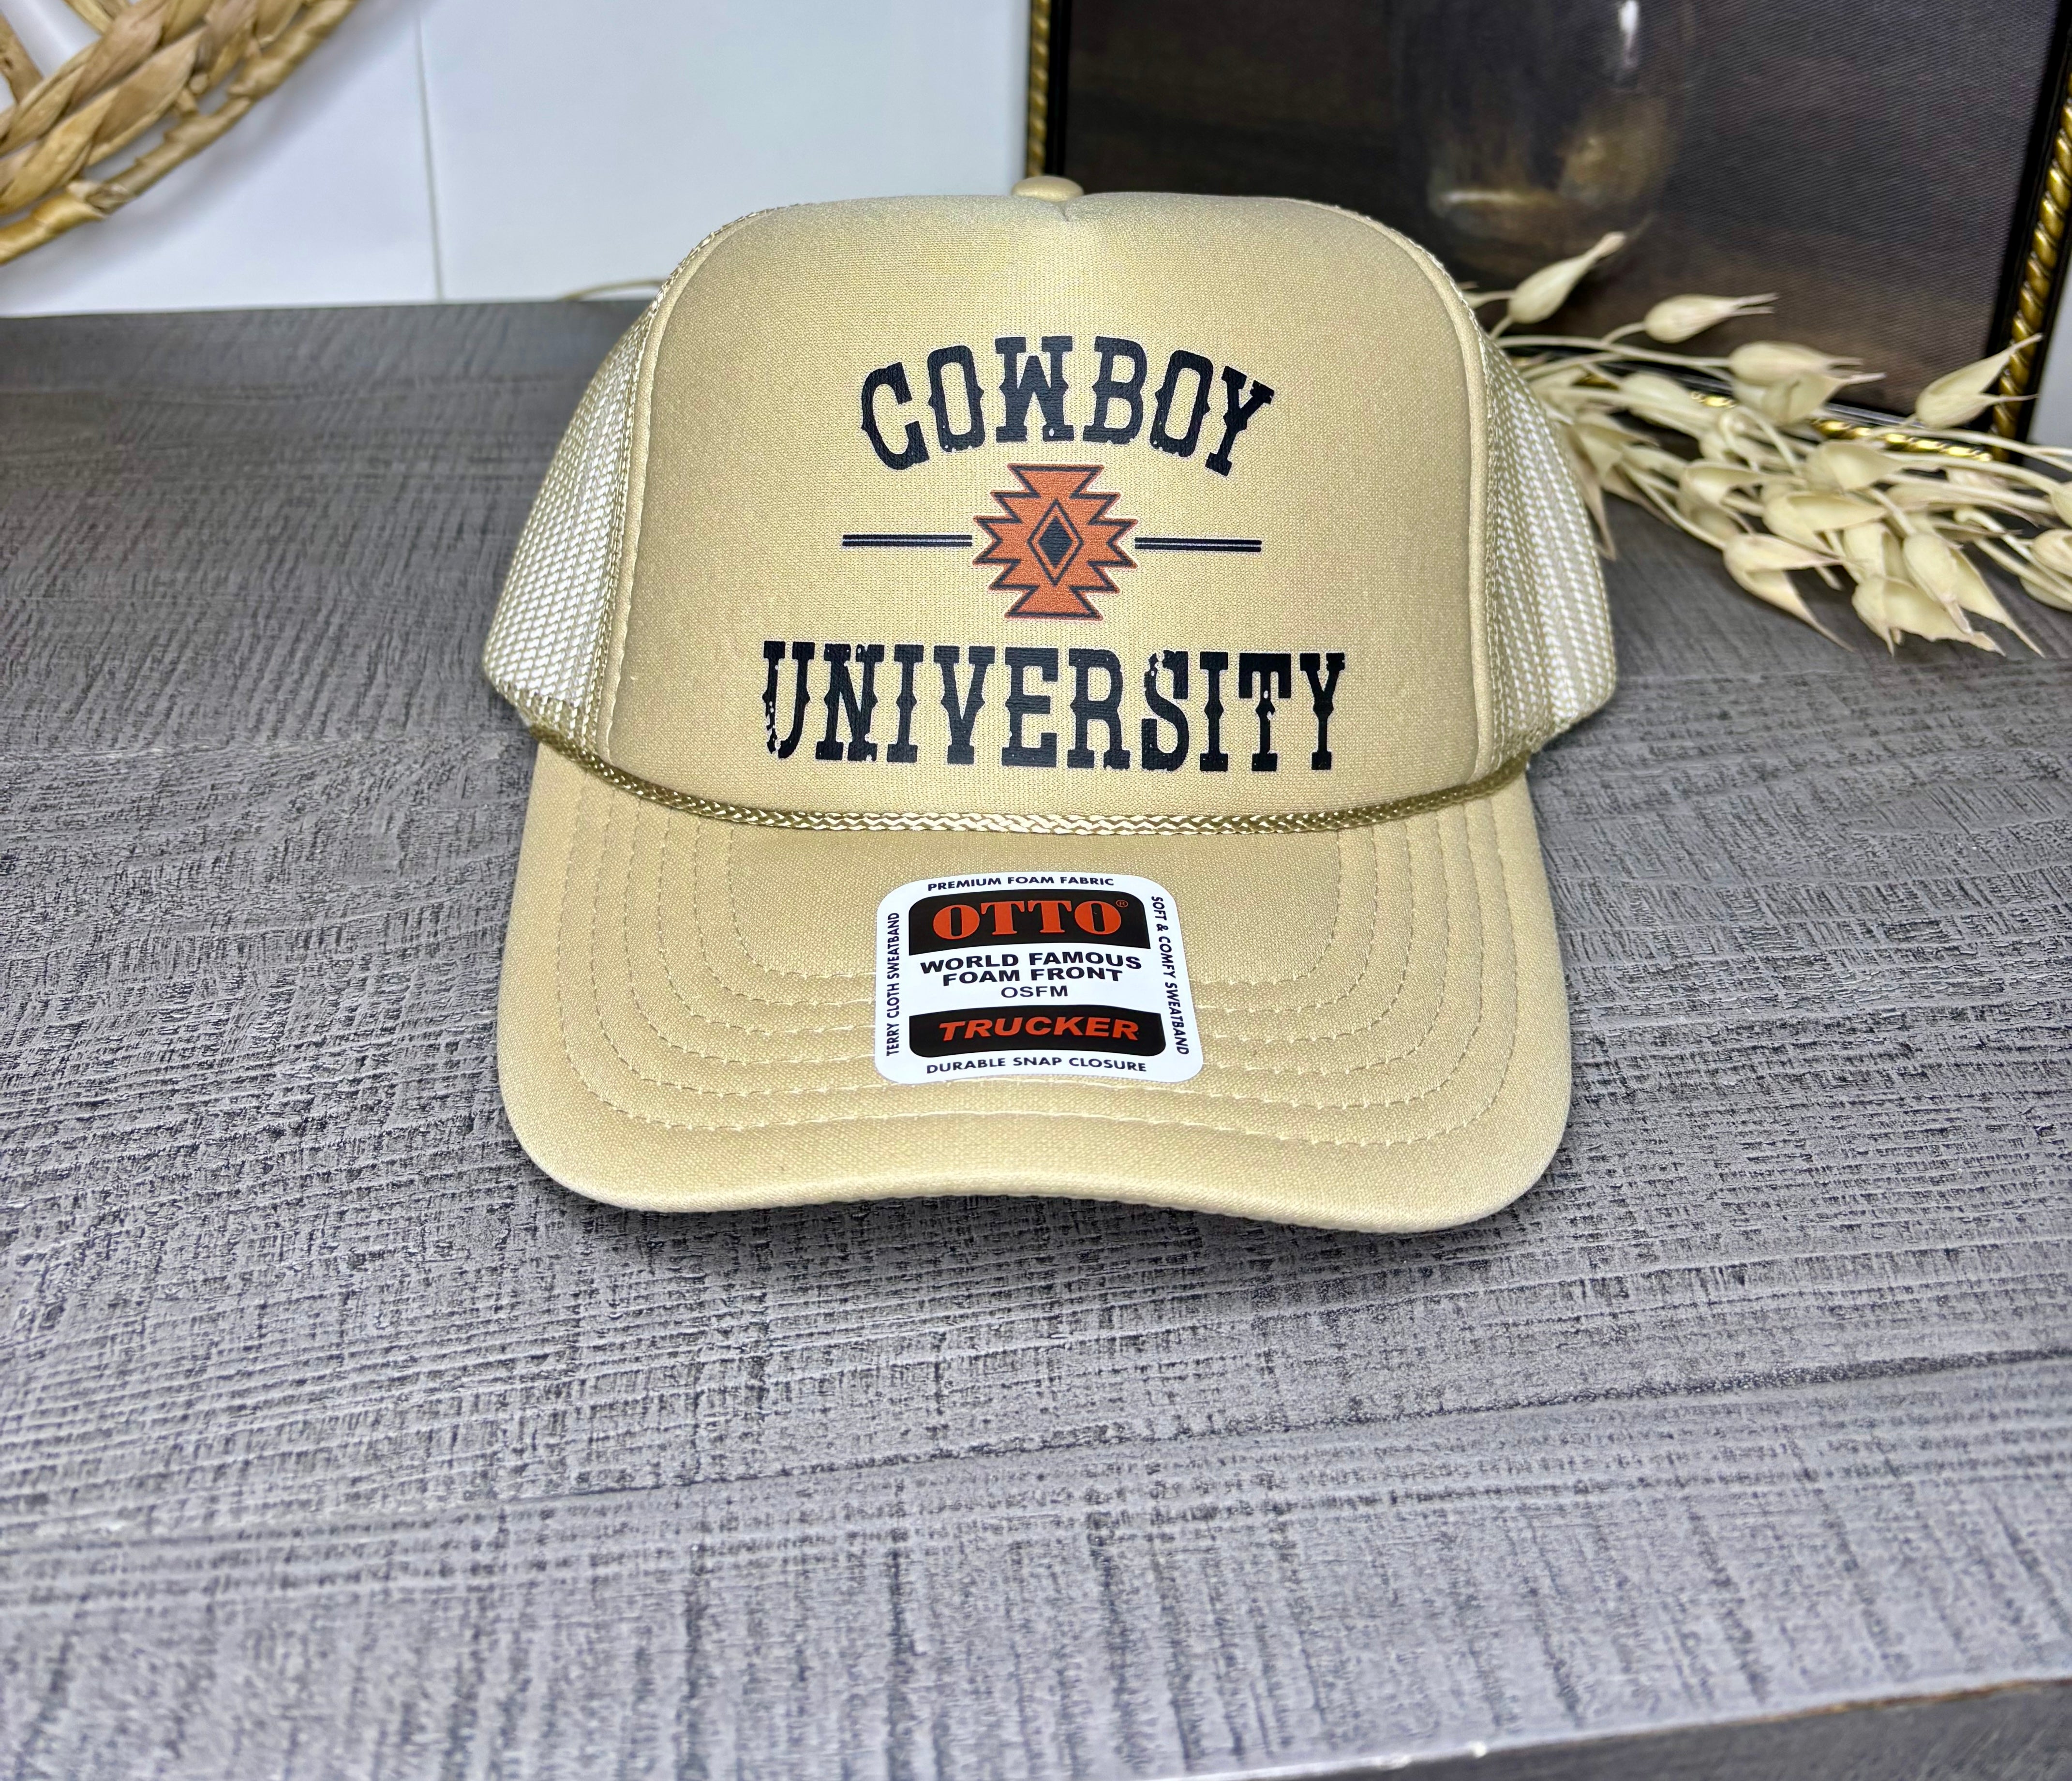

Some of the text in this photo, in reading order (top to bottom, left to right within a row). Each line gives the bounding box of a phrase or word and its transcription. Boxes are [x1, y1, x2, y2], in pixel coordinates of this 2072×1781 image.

[860, 335, 1275, 476] COWBOY
[762, 640, 1345, 772] UNIVERSITY
[928, 878, 1001, 890] PREMIUM
[1060, 877, 1114, 885] FABRIC
[1151, 896, 1166, 920] SOFT
[920, 951, 1142, 973] WORLD FAMOUS
[1159, 935, 1176, 979] COMFY
[887, 913, 899, 1056] TERRY CLOTH SWEATBAND
[942, 967, 1122, 986] FOAM FRONT
[1001, 986, 1068, 998] OSFM
[939, 1017, 1139, 1041] TRUCKER
[1165, 982, 1189, 1055] SWEATBAND
[926, 1057, 1147, 1073] DURABLE SNAP CLOSURE
